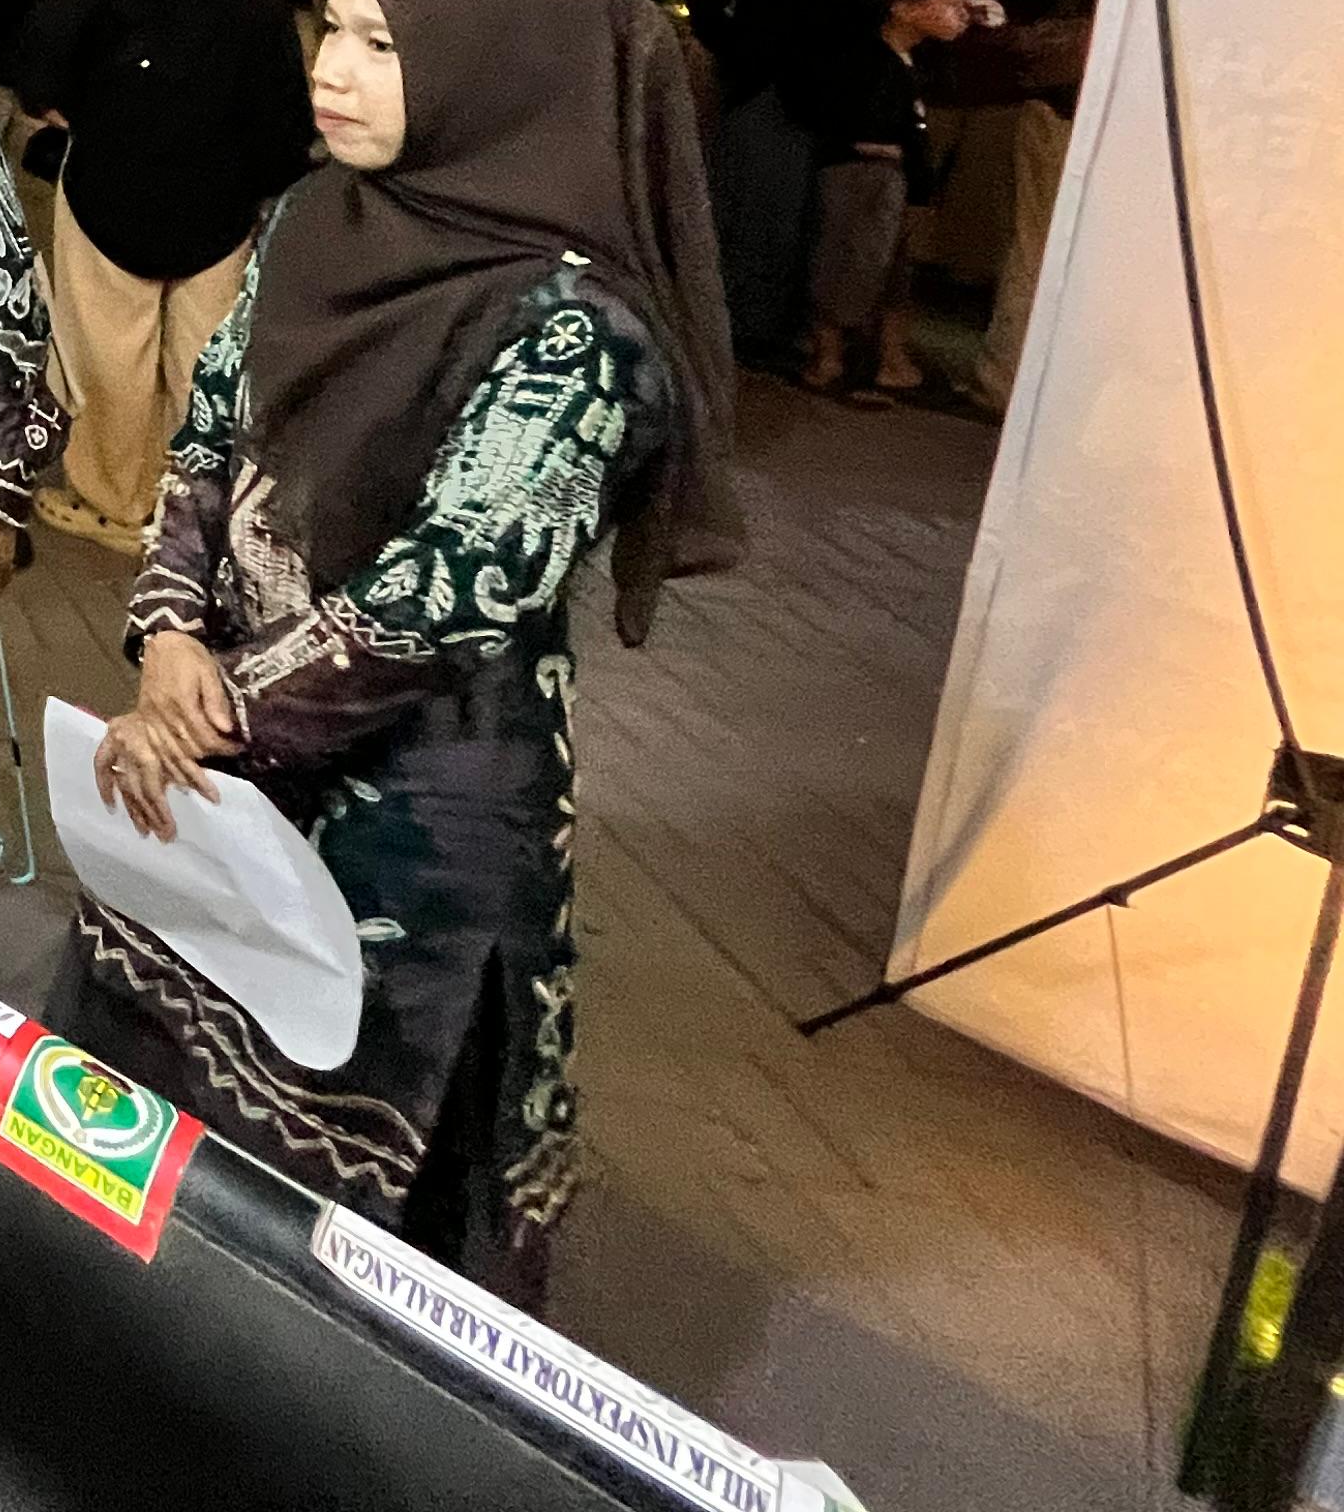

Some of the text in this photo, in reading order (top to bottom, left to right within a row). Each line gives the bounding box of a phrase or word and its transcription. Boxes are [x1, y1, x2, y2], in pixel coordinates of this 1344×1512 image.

[11, 1116, 134, 1211] BALANGAN
[503, 1338, 680, 1469] INSPEKTORAT
[681, 1445, 772, 1512] MILIK
